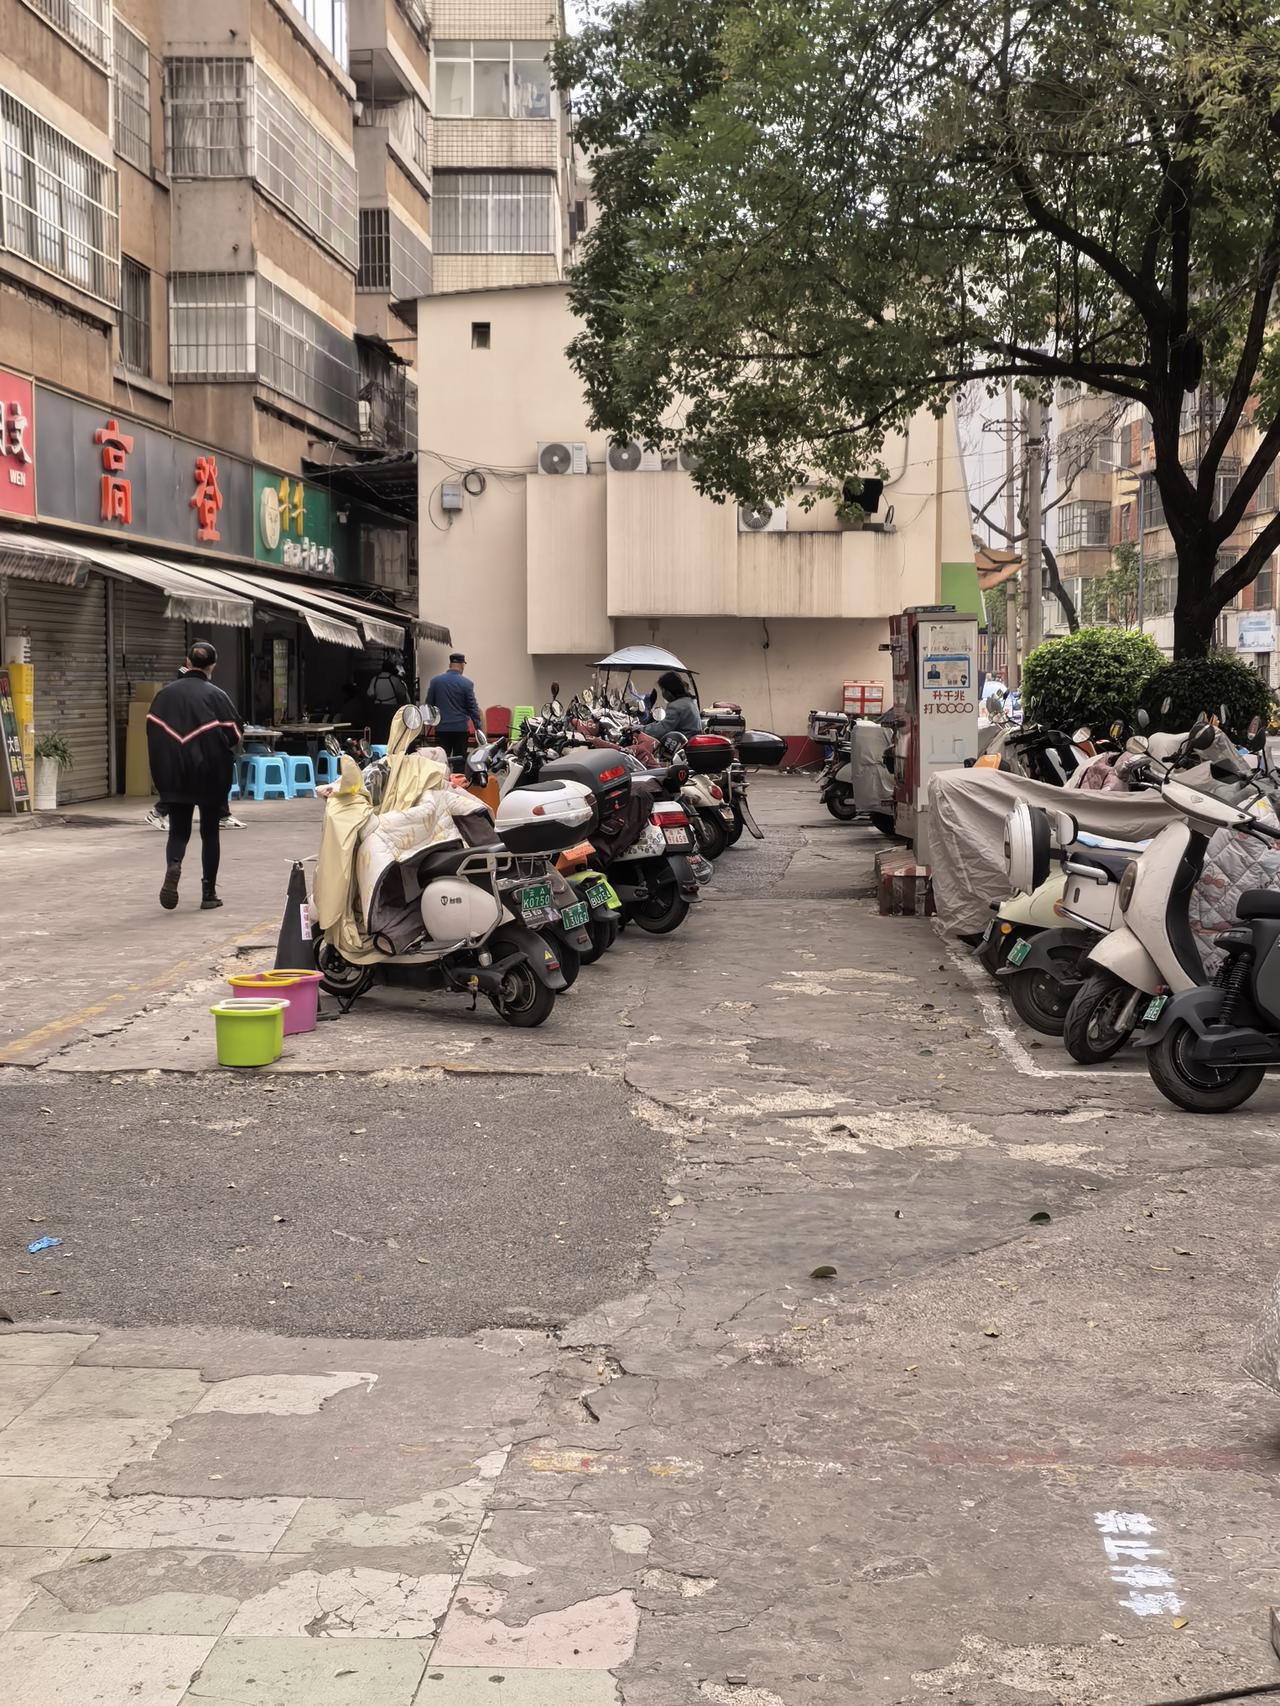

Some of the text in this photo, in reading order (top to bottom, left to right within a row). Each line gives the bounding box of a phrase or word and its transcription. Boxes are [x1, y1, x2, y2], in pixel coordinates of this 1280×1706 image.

[9, 469, 26, 486] WEN
[923, 702, 974, 714] 打10000
[523, 894, 550, 909] K0750
